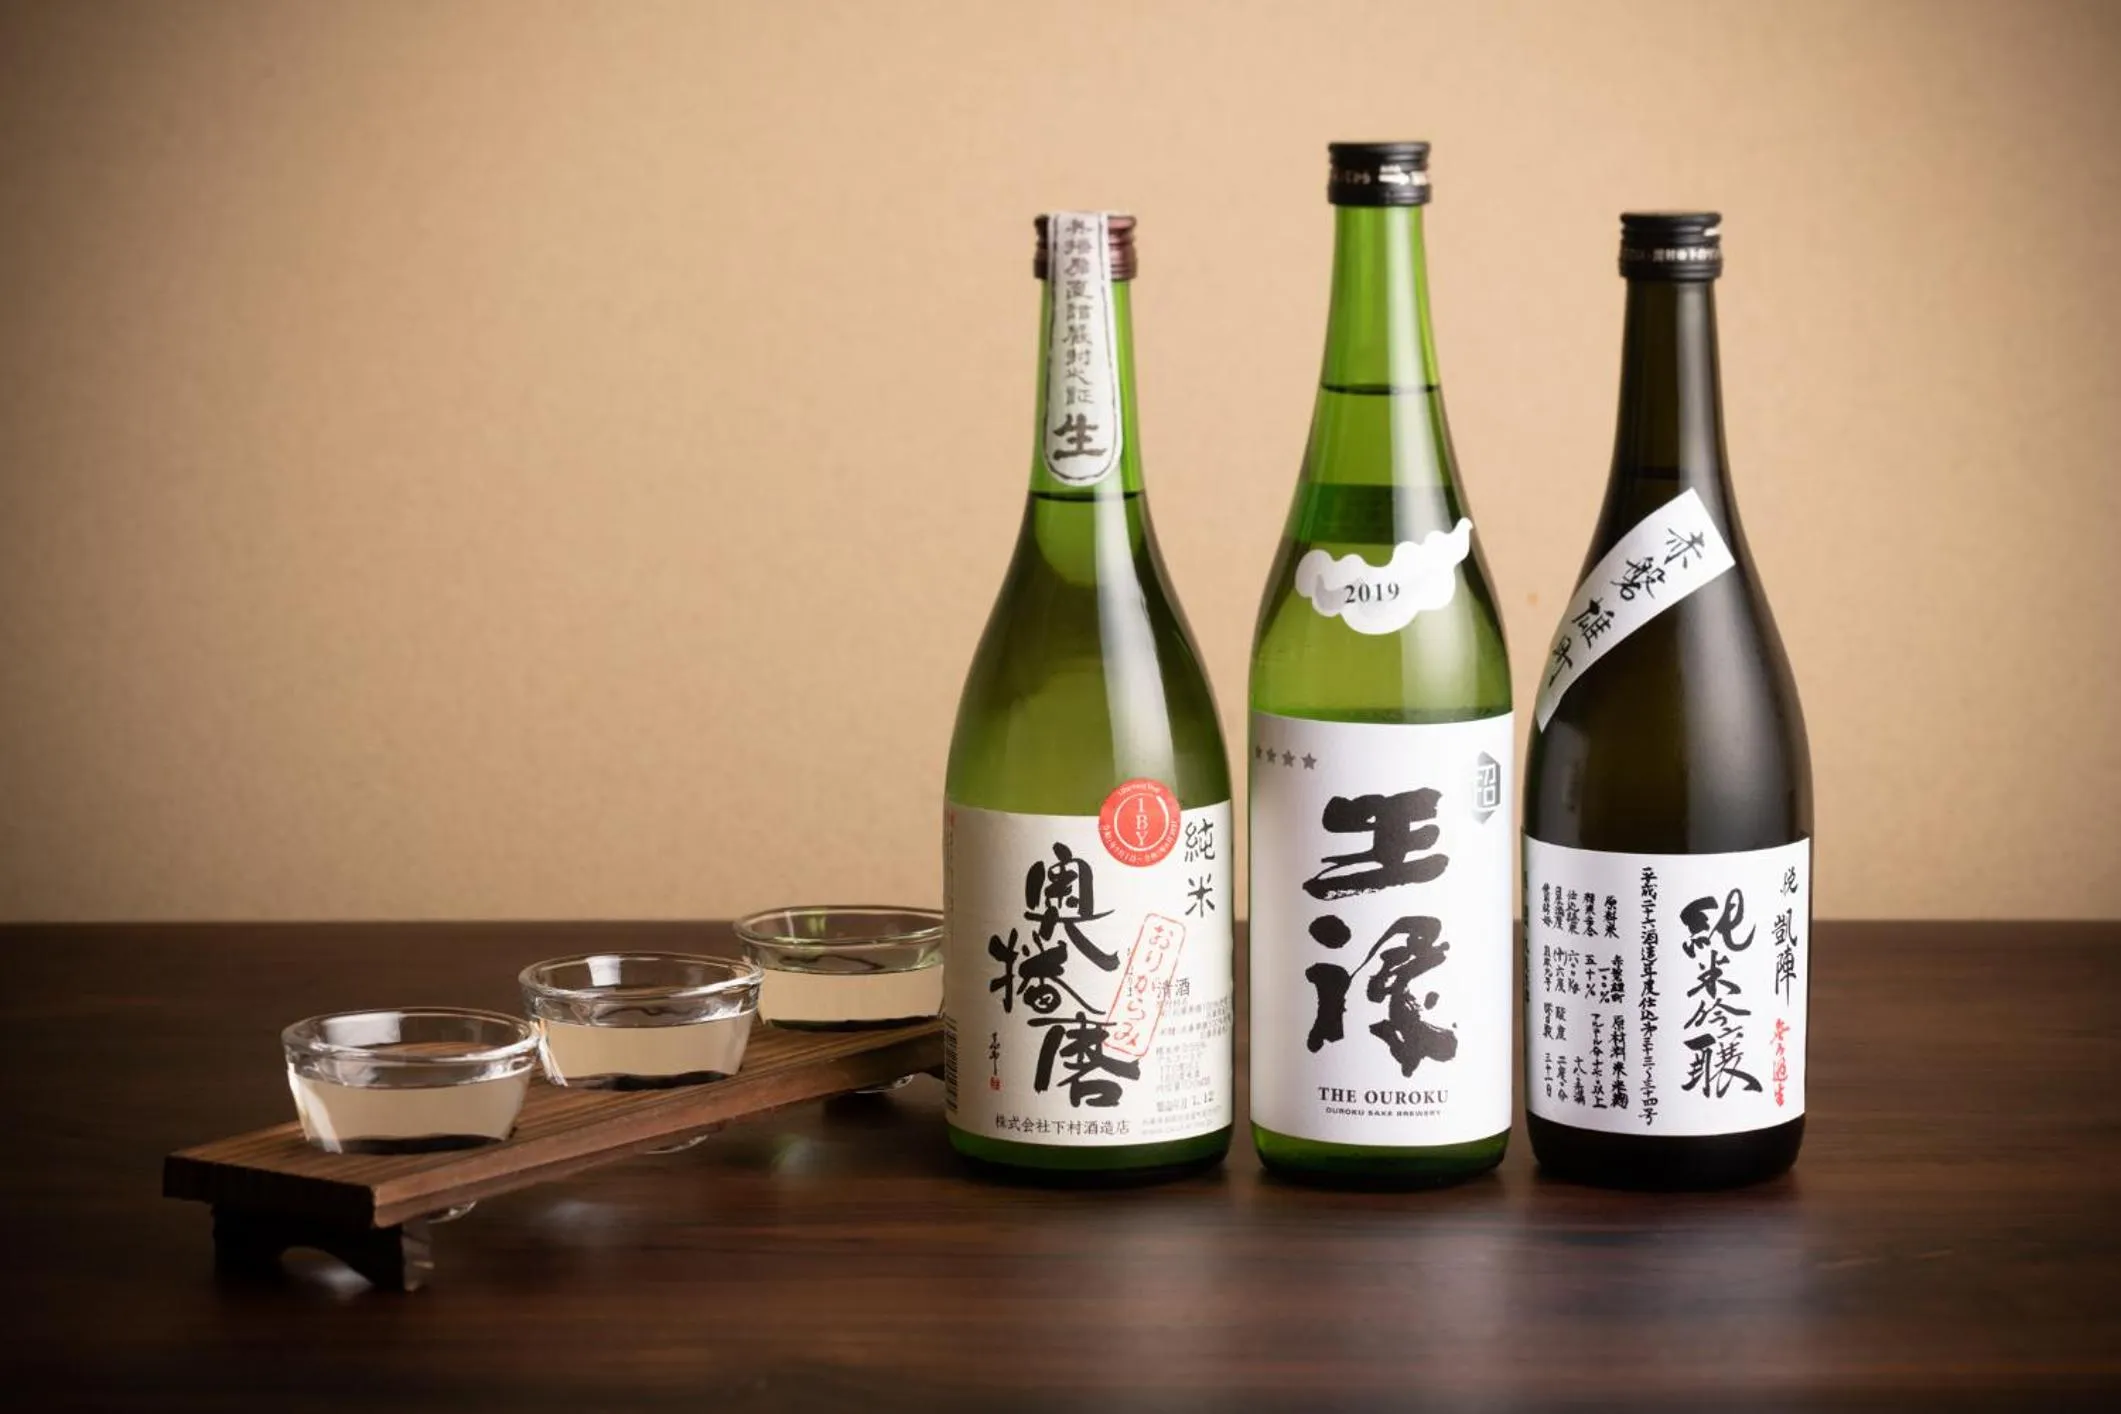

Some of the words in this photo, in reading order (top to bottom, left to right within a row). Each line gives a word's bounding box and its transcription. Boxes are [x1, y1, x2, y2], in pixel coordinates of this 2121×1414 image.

[1052, 412, 1107, 461] 生
[1344, 582, 1400, 604] 2019
[1184, 817, 1216, 918] 純米
[988, 842, 1141, 1108] 奥播磨
[1318, 1087, 1357, 1103] THE
[1364, 1089, 1449, 1105] OUROKU
[1325, 1106, 1365, 1116] OUROKU
[995, 1112, 1130, 1135] 株式会社下村酒造店
